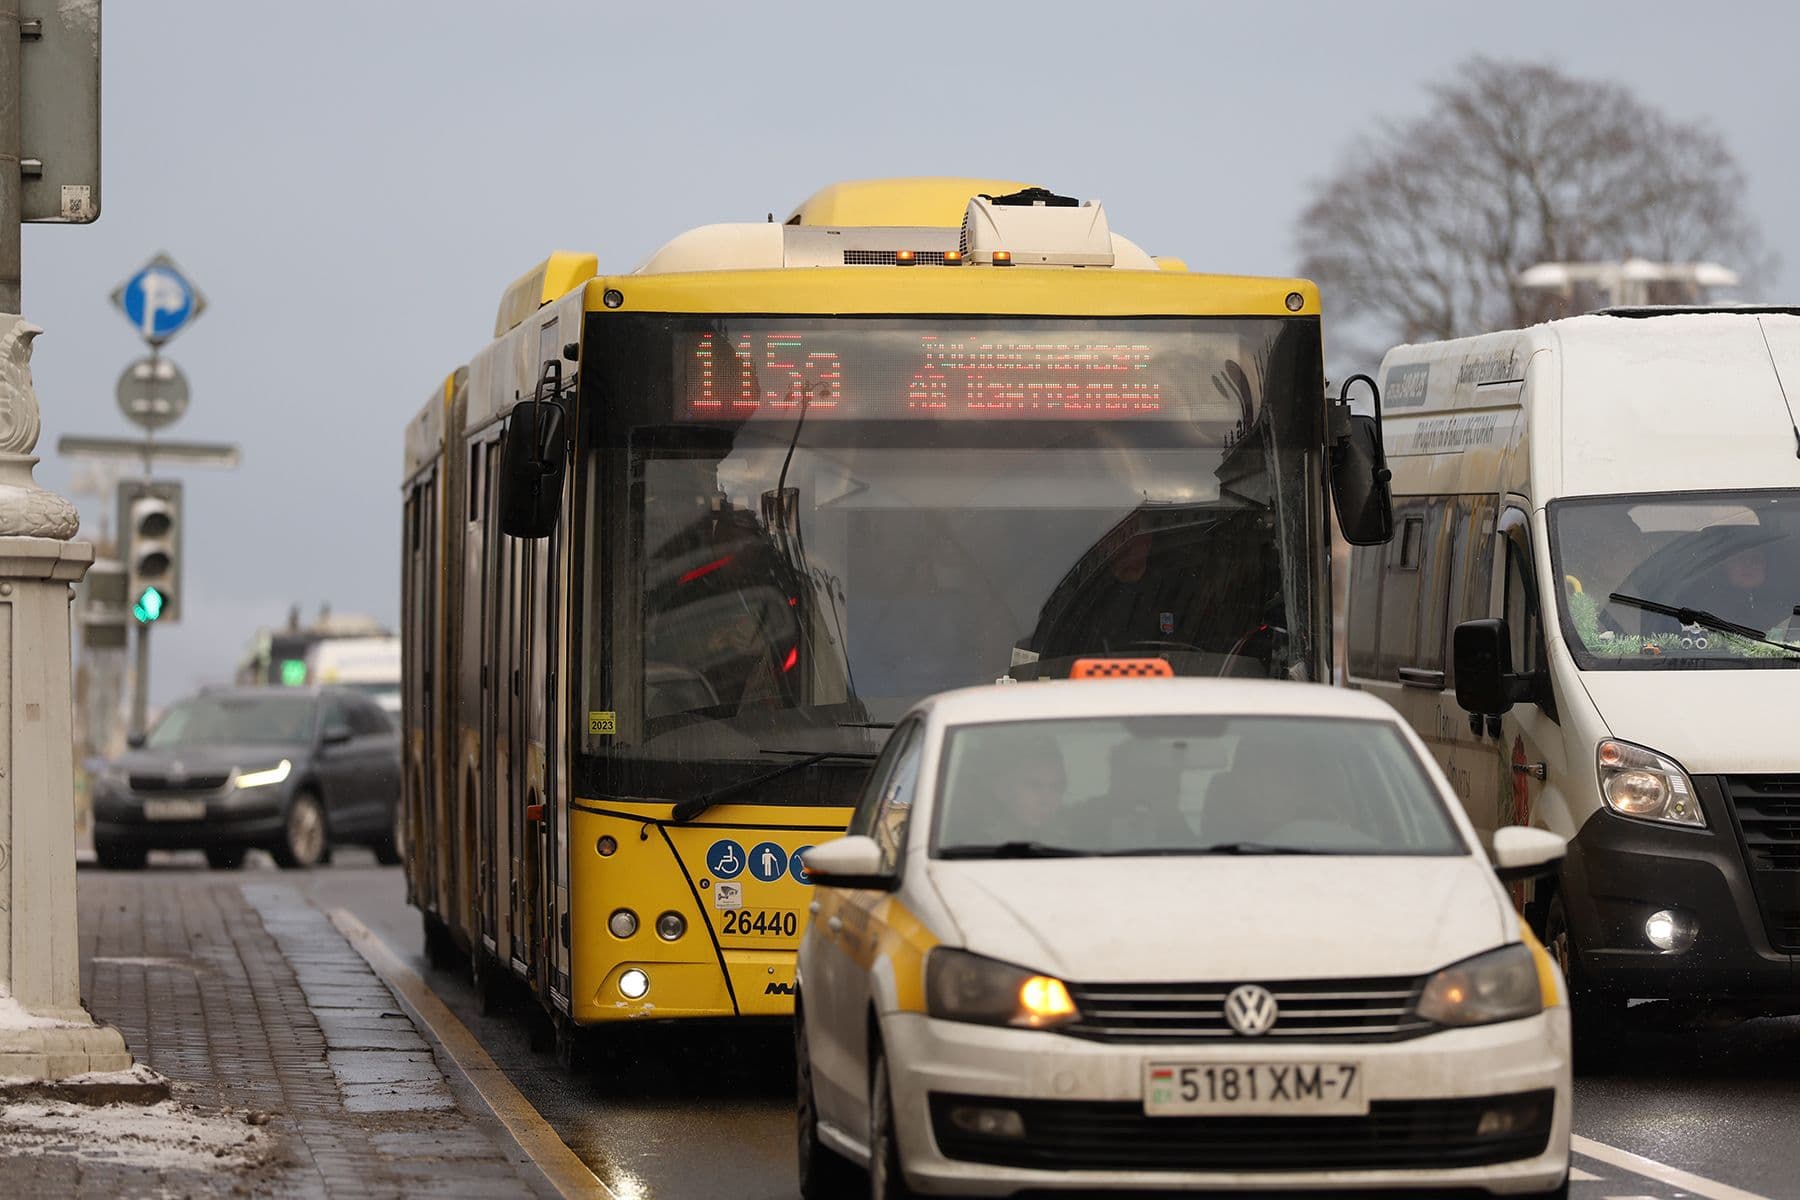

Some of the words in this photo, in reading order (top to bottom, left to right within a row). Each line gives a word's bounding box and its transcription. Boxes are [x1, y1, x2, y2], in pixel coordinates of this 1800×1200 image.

[909, 375, 947, 408] АВ
[591, 720, 614, 730] 2023
[722, 910, 797, 936] 26440
[1180, 1067, 1258, 1102] 5181
[1269, 1065, 1357, 1100] XM-7
